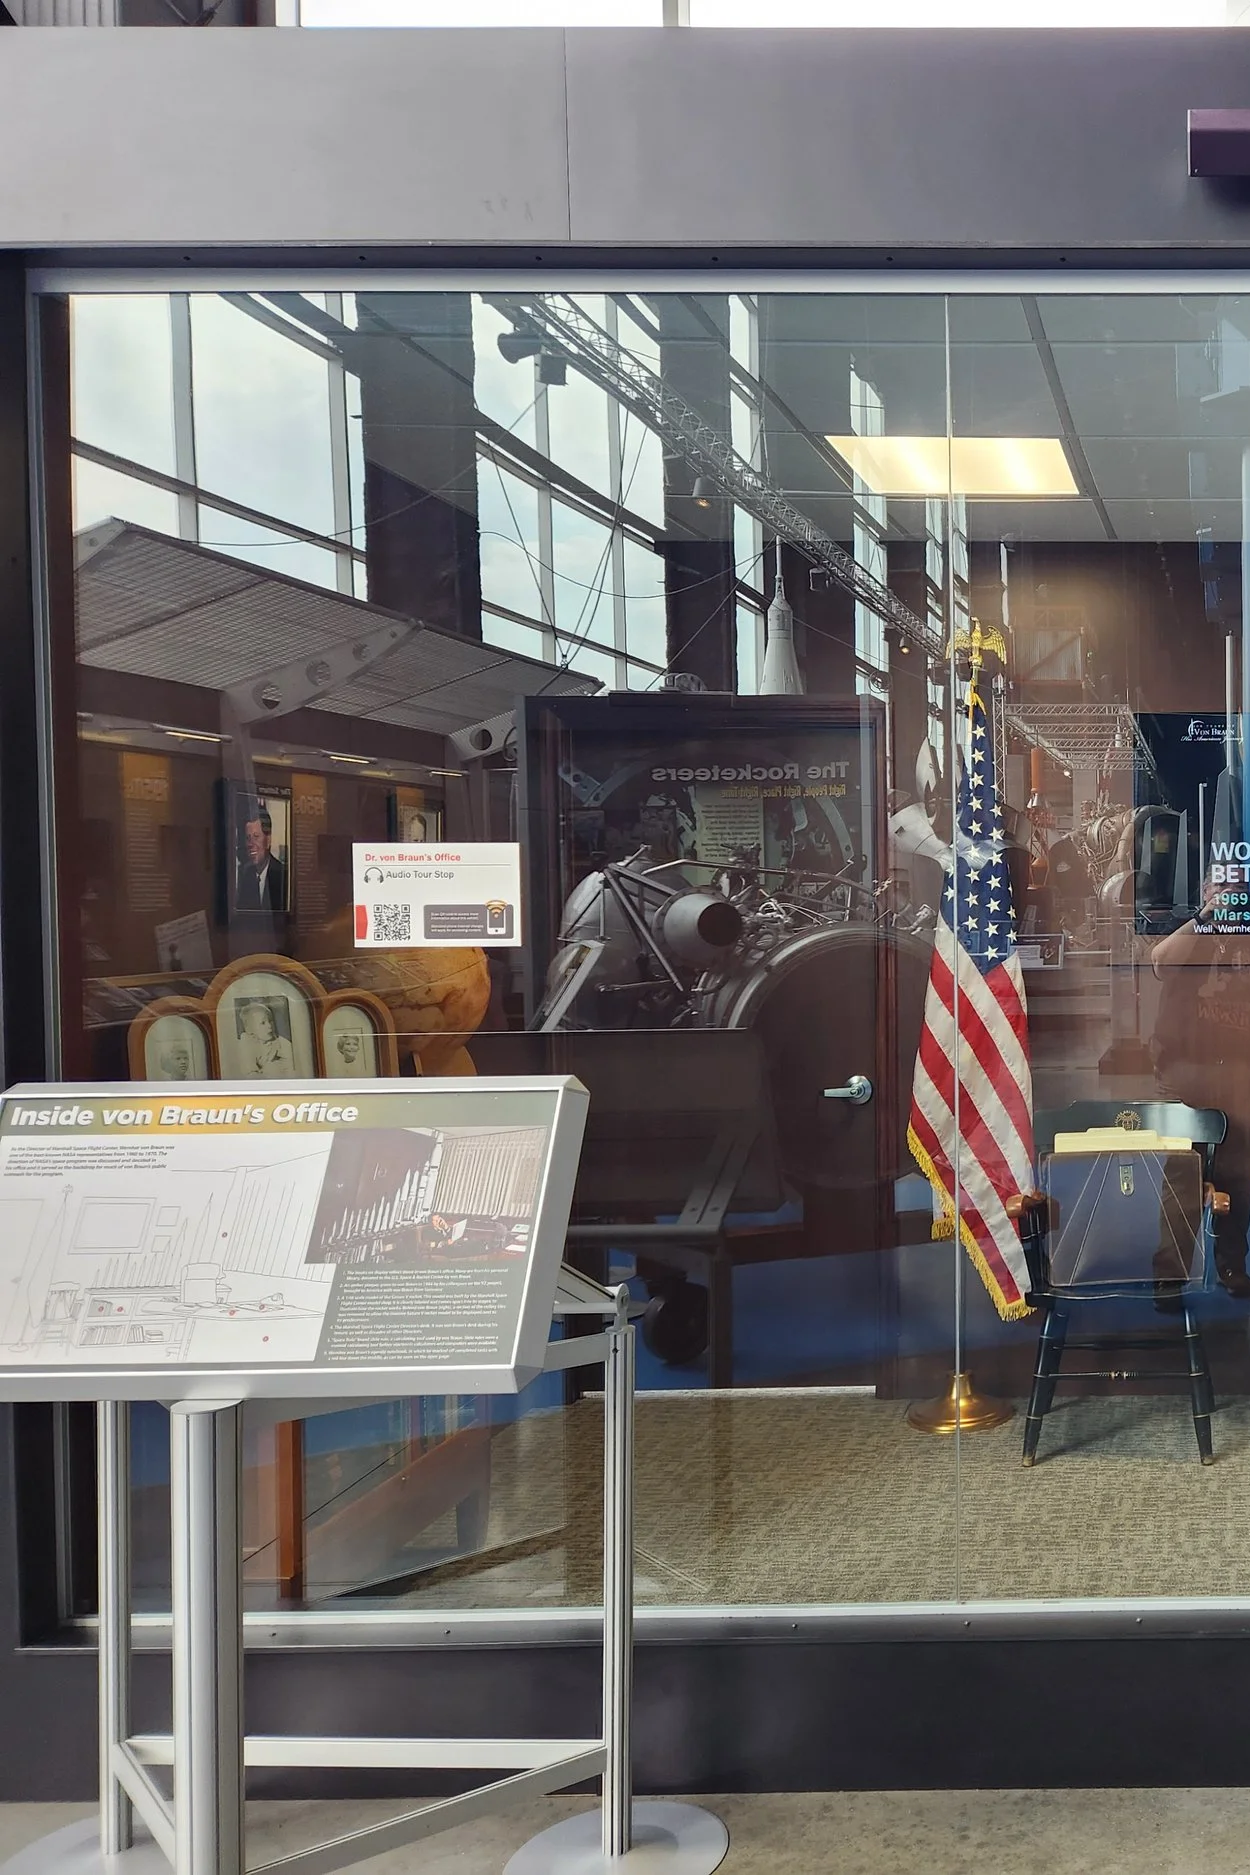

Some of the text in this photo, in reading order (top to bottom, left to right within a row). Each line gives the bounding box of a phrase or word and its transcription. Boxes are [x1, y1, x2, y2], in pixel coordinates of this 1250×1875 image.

[365, 853, 461, 862] Dr. von Braun's Office
[386, 870, 455, 880] Audio Tour Stop
[1193, 924, 1216, 934] Well,
[10, 1101, 360, 1126] Inside von Braun's Office
